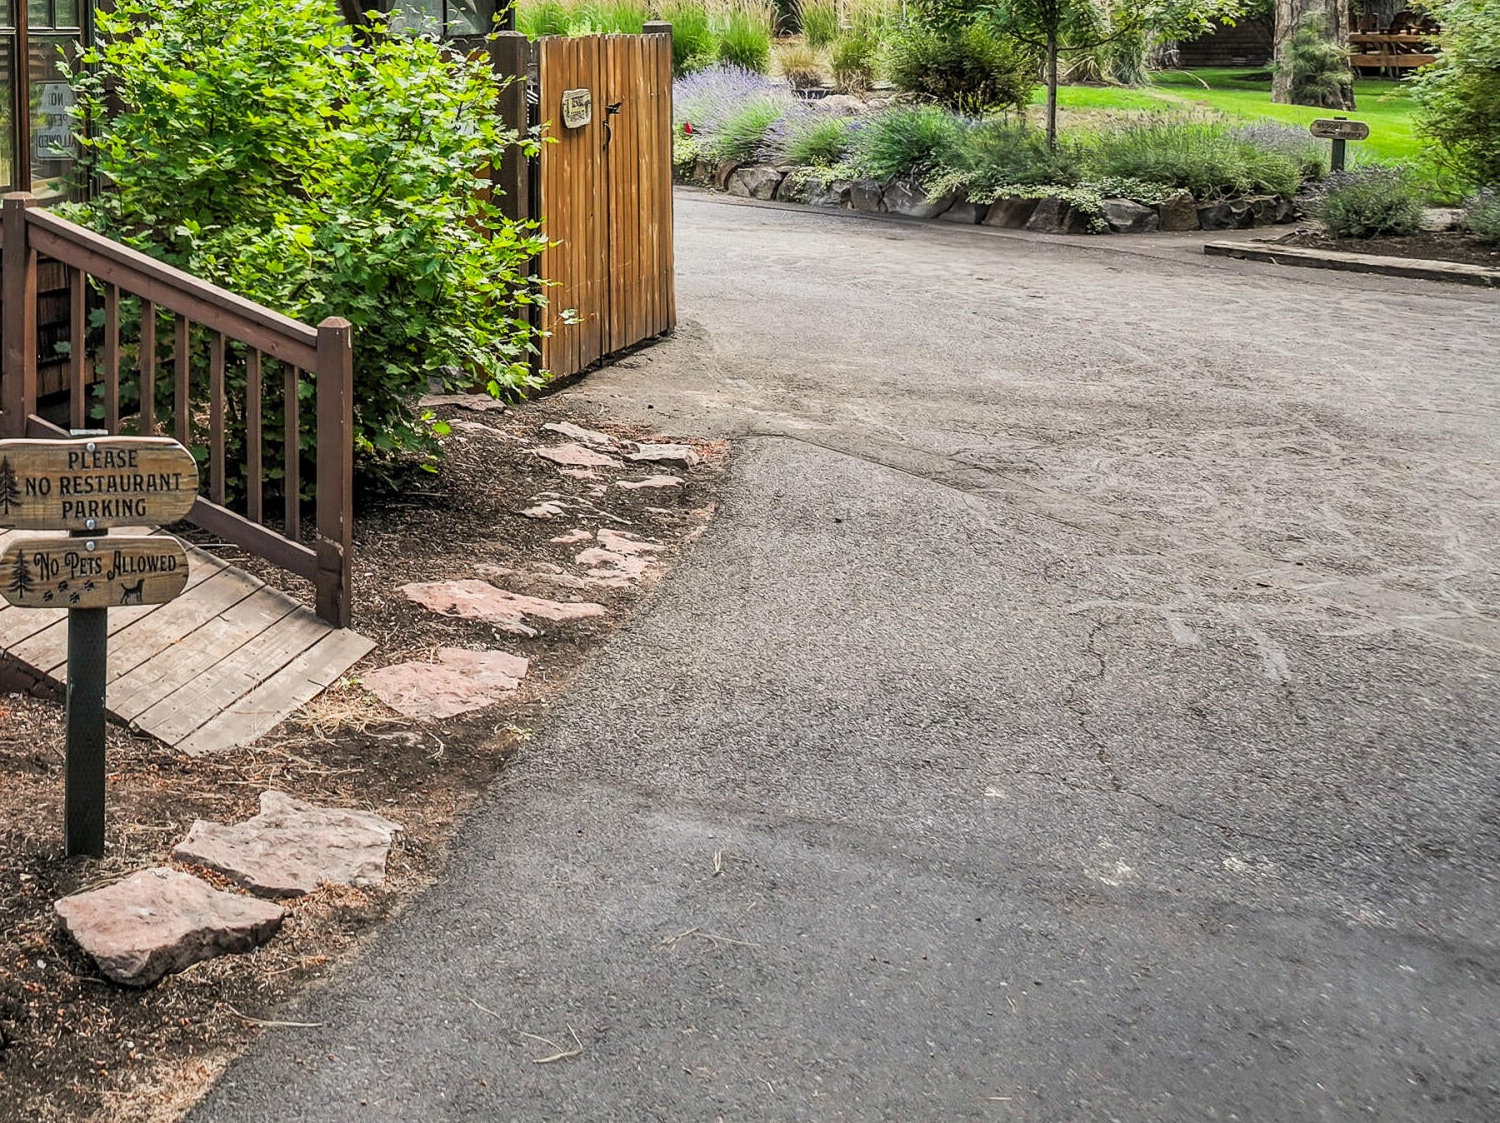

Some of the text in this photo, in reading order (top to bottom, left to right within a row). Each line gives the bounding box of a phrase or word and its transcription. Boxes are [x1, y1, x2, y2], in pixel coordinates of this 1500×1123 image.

[68, 449, 139, 471] PLEASE
[25, 473, 182, 496] NO RESTAURANT
[61, 498, 147, 519] PARKING
